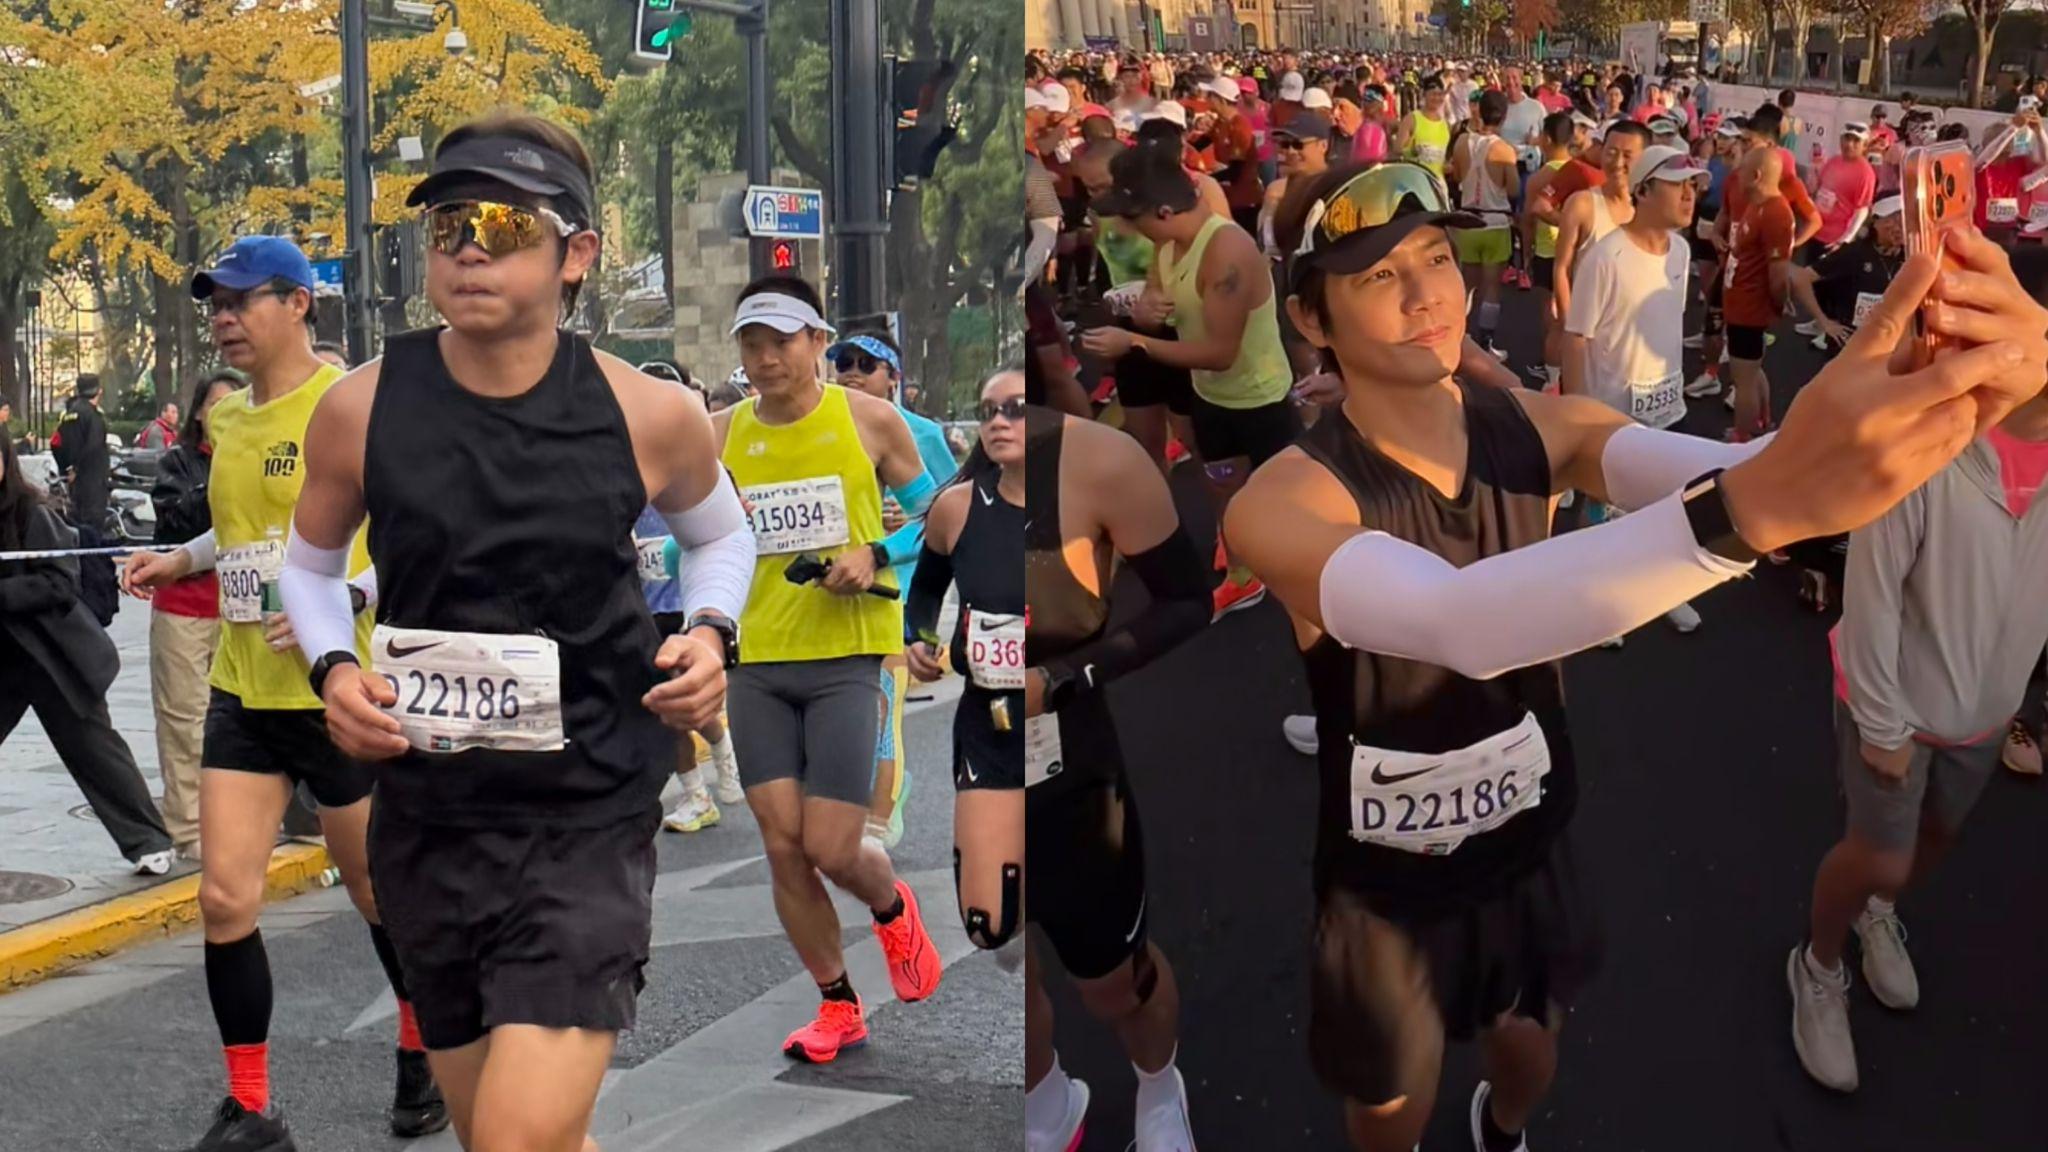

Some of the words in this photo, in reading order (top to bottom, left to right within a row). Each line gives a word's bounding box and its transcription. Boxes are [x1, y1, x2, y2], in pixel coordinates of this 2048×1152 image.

[757, 501, 825, 533] 15034
[973, 641, 986, 663] D
[406, 669, 520, 721] 22186
[1362, 797, 1387, 830] D
[1395, 769, 1518, 832] 22186
